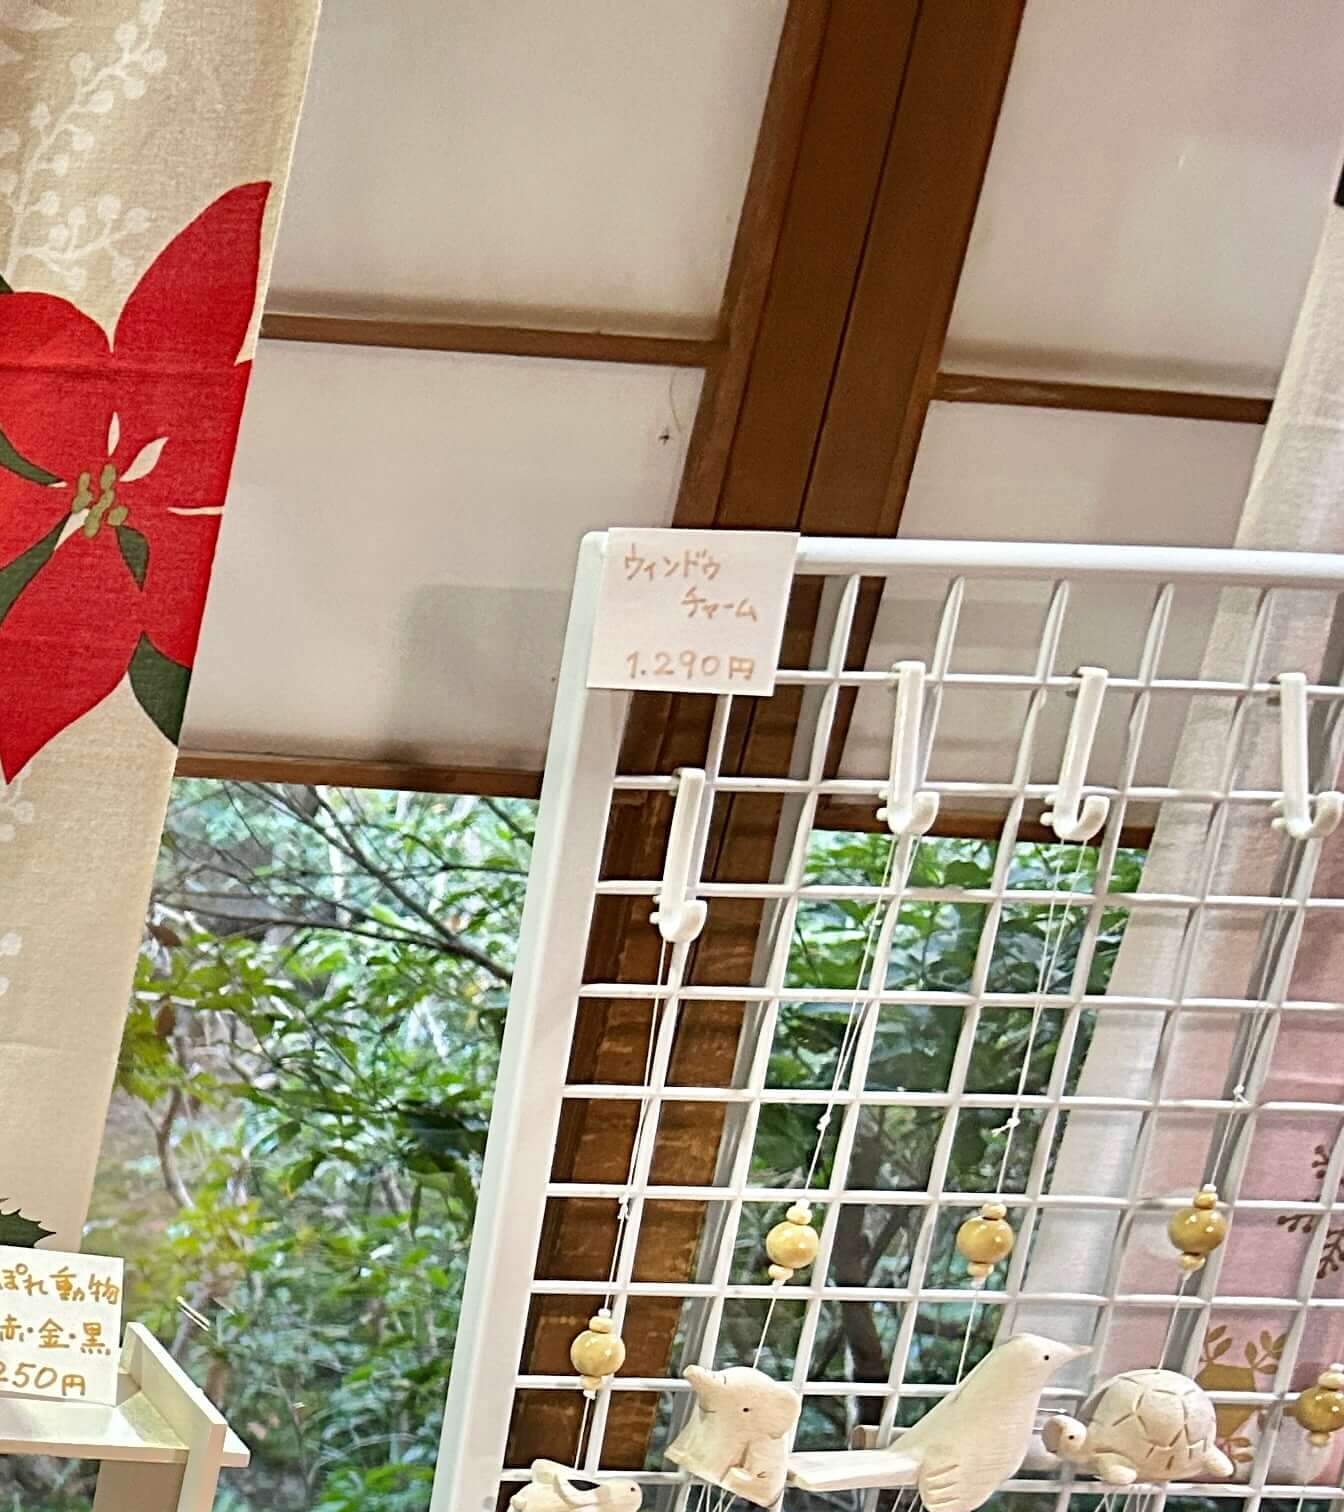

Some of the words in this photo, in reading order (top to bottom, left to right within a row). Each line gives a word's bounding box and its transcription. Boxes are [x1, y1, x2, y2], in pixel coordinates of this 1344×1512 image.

[681, 586, 758, 622] チャーム
[625, 650, 755, 681] 1.290円
